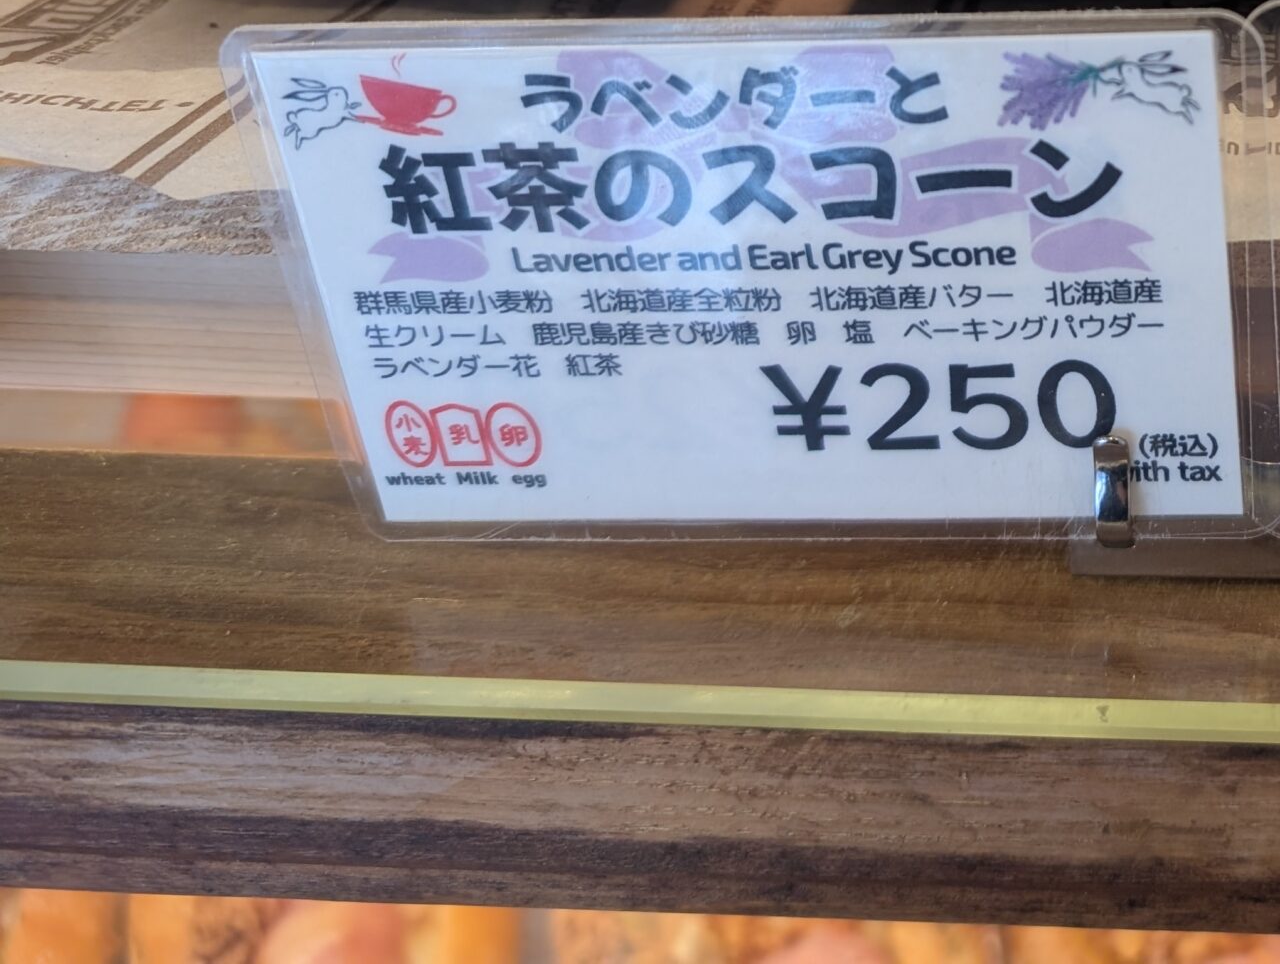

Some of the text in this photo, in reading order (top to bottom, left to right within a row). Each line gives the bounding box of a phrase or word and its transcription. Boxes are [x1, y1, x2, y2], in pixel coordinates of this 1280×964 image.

[521, 65, 949, 133] ラベンダーと
[379, 139, 1123, 234] 紅茶のスコーン
[512, 241, 1017, 275] Lavender and Earl Grey Scone
[354, 277, 1164, 316] 群馬県産小麦粉 北海道産全粒粉 北海道産バター 北海道産
[364, 312, 1165, 348] 生クリーム 鹿児島産きび砂糖 卵 塩 ベーキングパウダー
[373, 352, 623, 379] ラベンダー花 紅茶
[759, 358, 1117, 452] ¥250
[395, 413, 529, 456] 小麦 乳 卵
[1138, 432, 1218, 459] (税込)
[385, 471, 548, 488] wheat Milk egg
[1130, 460, 1223, 482] ith tax
